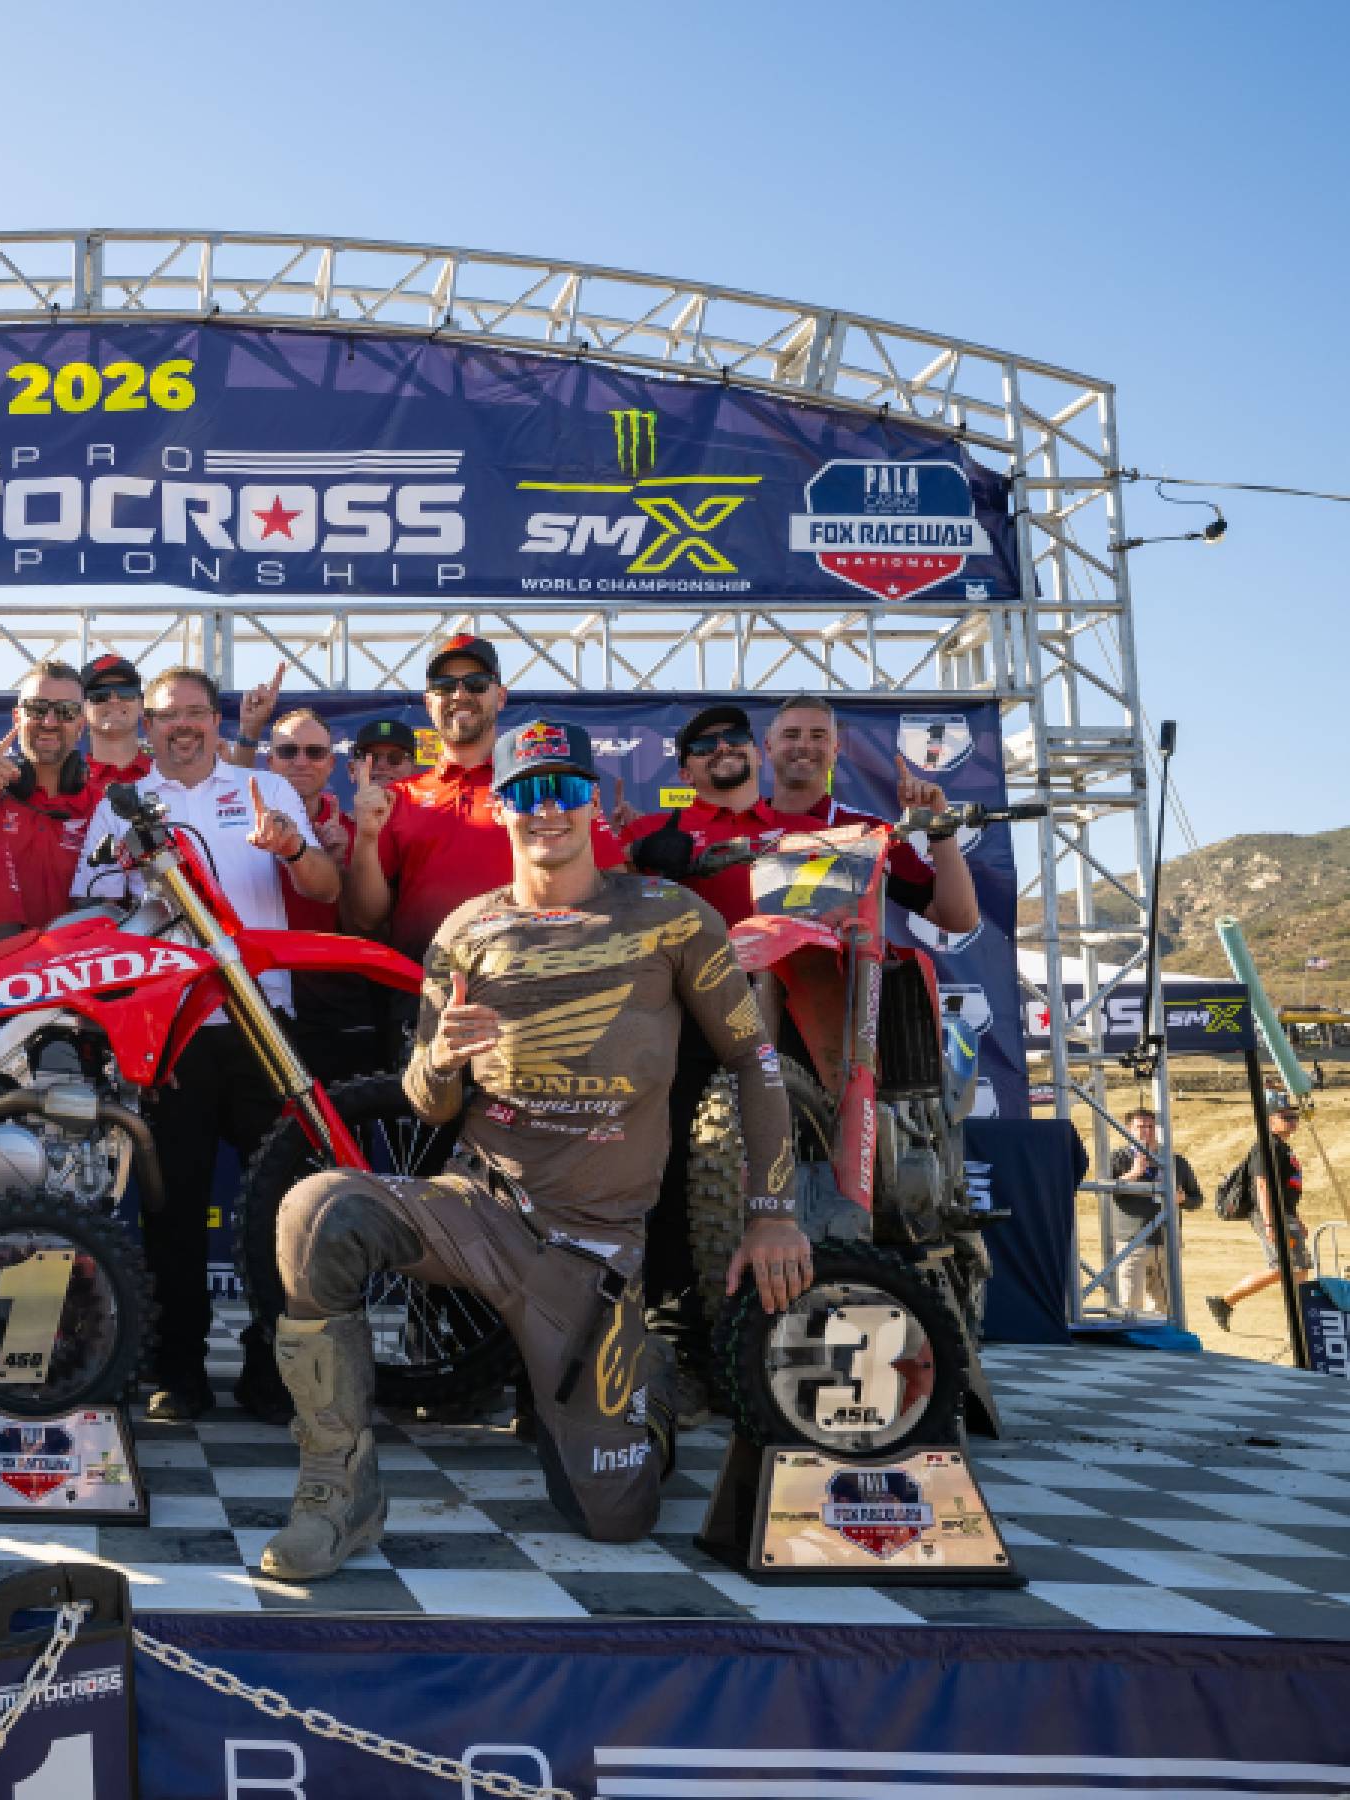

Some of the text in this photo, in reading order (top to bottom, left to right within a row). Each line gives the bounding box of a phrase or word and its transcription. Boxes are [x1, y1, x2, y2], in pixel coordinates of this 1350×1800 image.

[6, 359, 196, 415] 2026
[11, 444, 193, 473] PRO
[518, 496, 746, 575] SMX
[808, 521, 973, 547] FOX RACEWAY
[835, 556, 948, 569] NATIONAL
[521, 577, 751, 592] WORLD CHAMPIONSHIP
